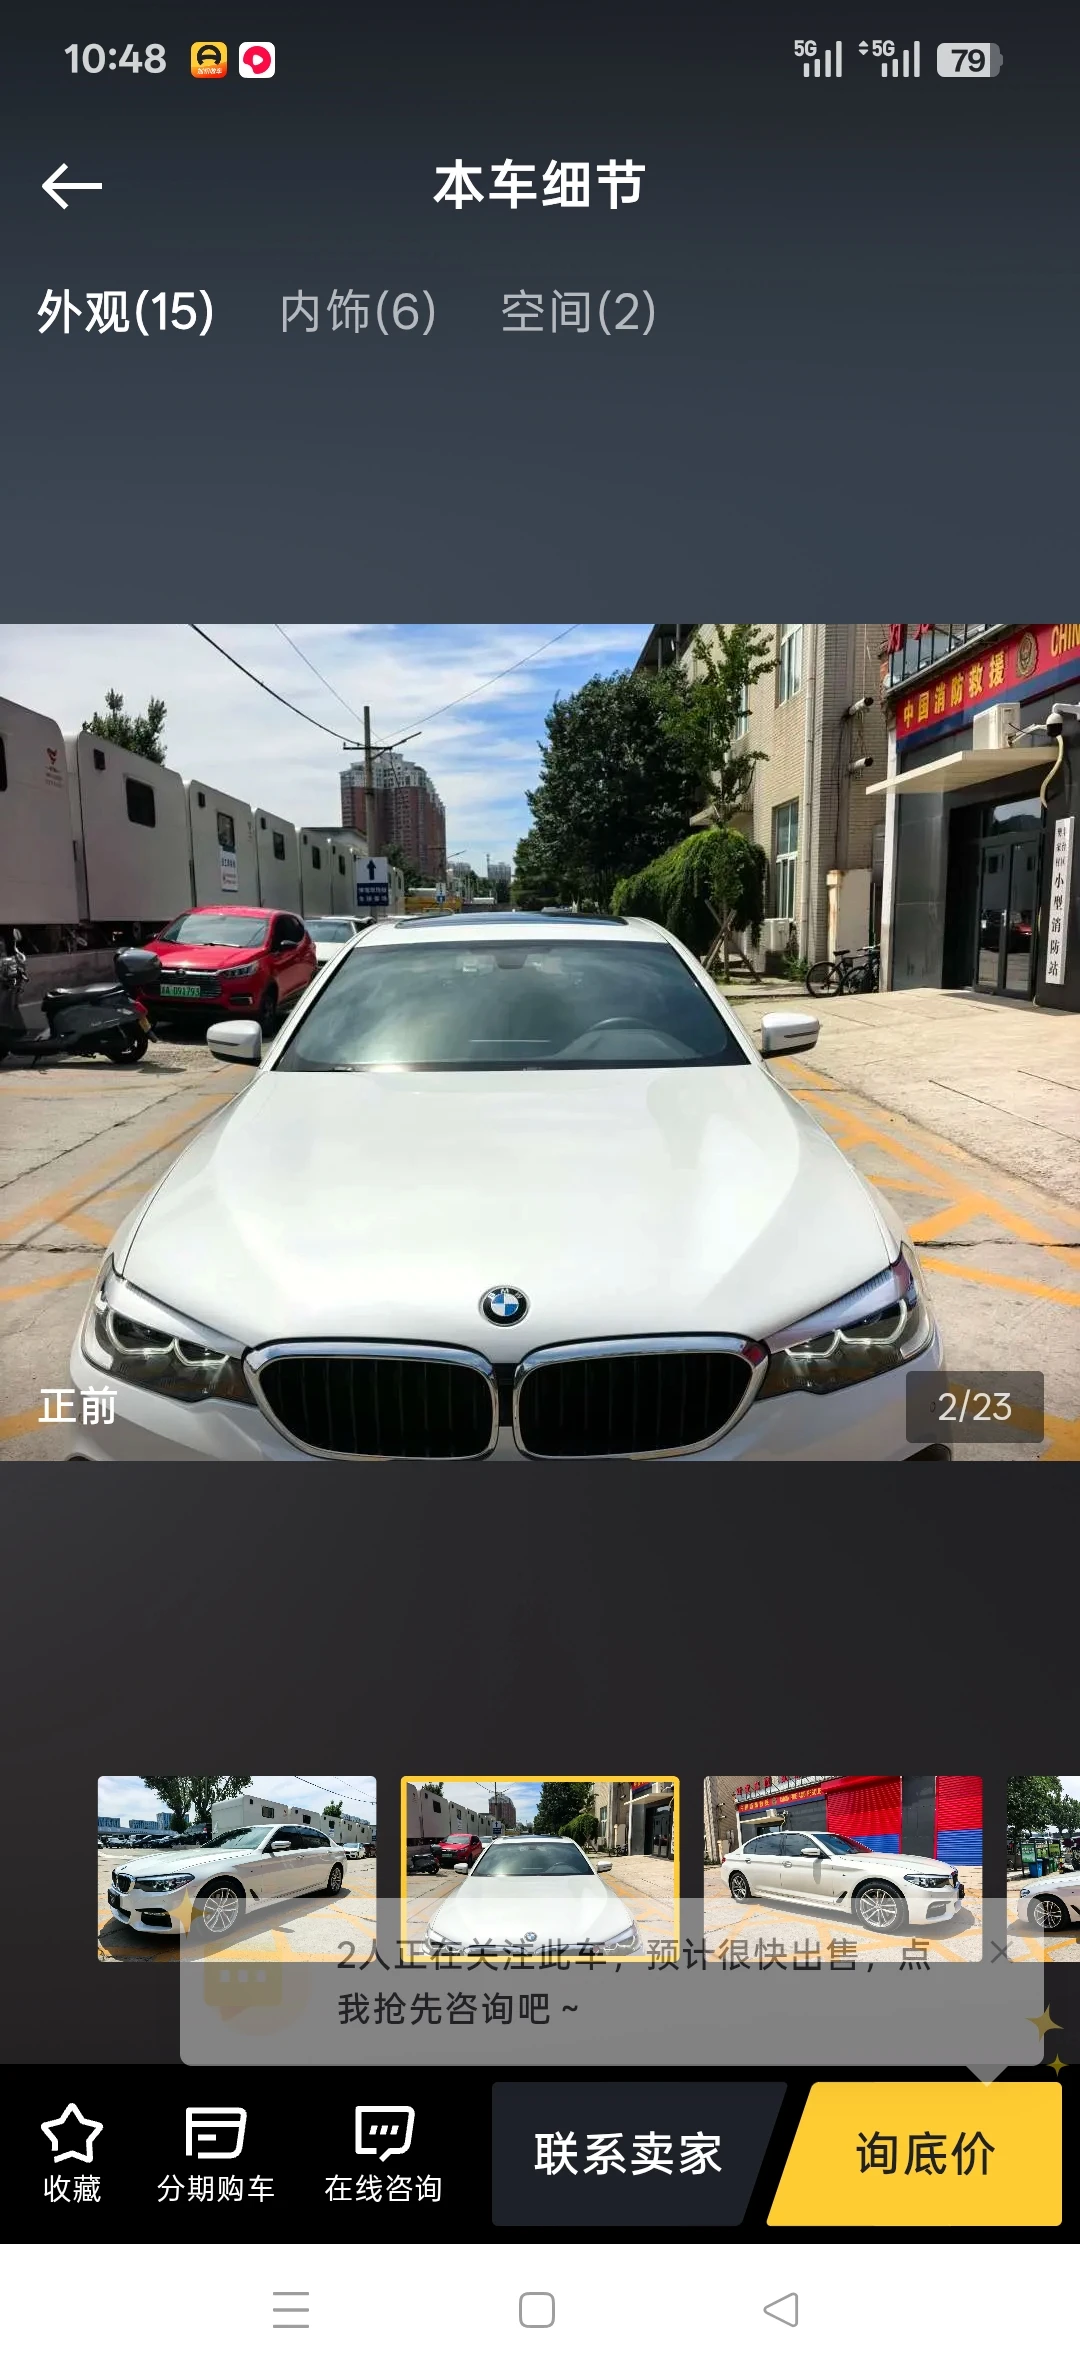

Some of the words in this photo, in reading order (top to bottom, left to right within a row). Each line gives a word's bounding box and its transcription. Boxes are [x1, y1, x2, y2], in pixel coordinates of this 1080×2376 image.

[65, 43, 167, 74] 10:48
[793, 40, 818, 57] 5G
[871, 40, 896, 57] 5G
[951, 48, 986, 73] 79
[432, 157, 646, 210] 本车细节
[36, 288, 214, 337] 外观(15)
[281, 288, 436, 336] 内饰(6)
[501, 288, 656, 336] 空间(2)
[903, 649, 1006, 728] 中国消防救援
[1048, 872, 1064, 977] 小型消防站
[337, 1937, 932, 1972] 2人正在关注此车，预计很快出售，点
[534, 2130, 723, 2176] 联系卖家
[856, 2130, 996, 2176] 询底价
[43, 2174, 102, 2204] 收藏
[157, 2173, 275, 2203] 分期购车
[324, 2173, 442, 2203] 在线咨询
